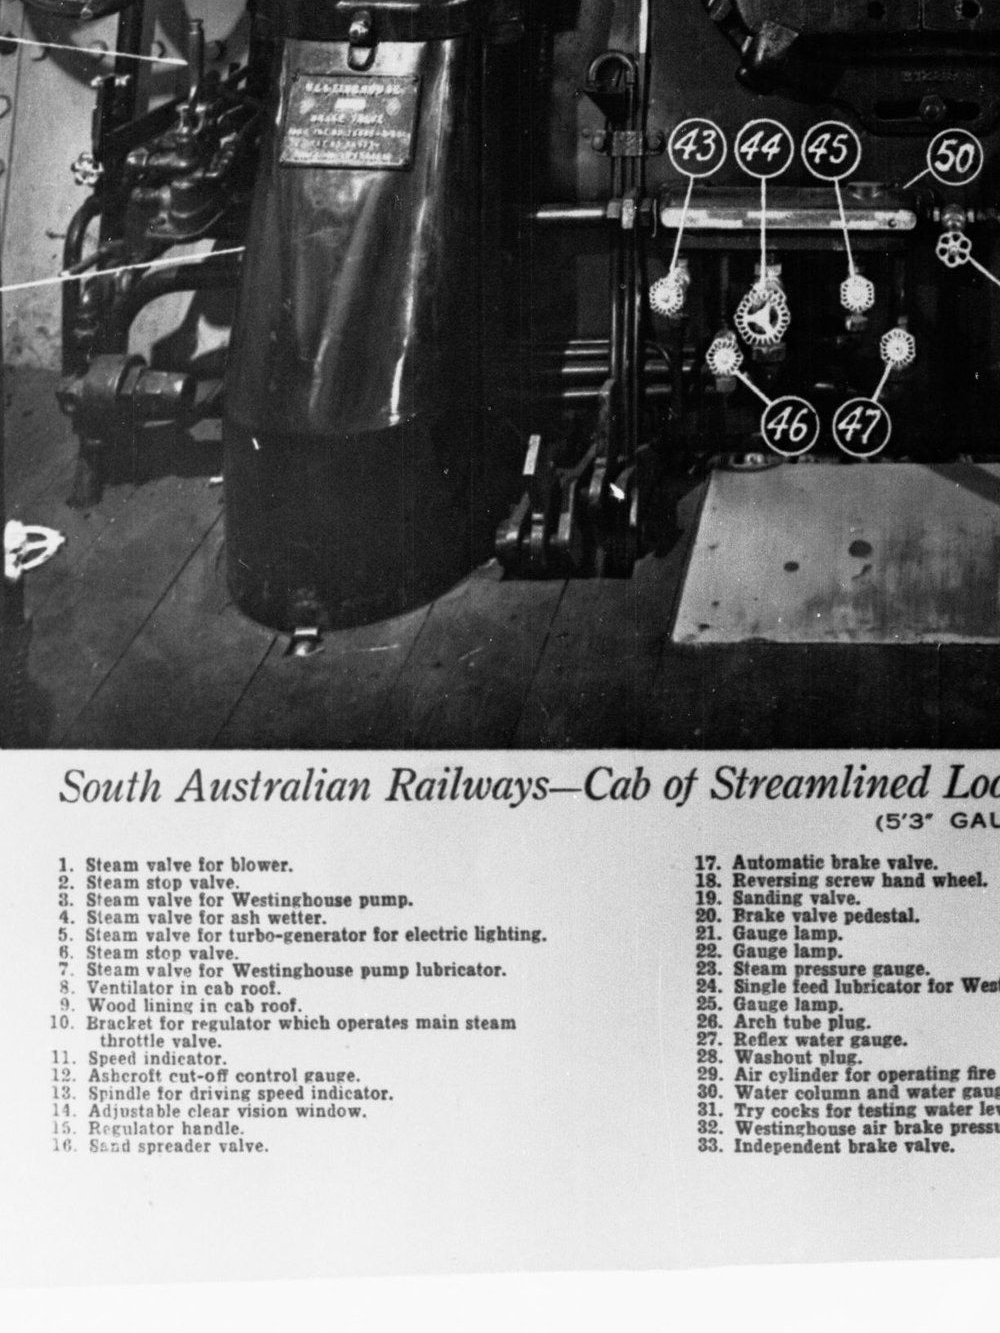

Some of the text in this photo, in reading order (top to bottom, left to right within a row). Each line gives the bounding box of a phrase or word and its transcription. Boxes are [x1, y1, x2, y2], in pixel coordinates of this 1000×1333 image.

[59, 768, 161, 803] South
[174, 767, 371, 803] Australian
[663, 767, 699, 808] of
[709, 763, 933, 801] Streamlined
[58, 857, 294, 872] 1. Steam valve for blower.
[695, 873, 989, 890] 18. Reversing screw hand wheel.
[57, 893, 414, 910] 3. Steam valve for Westinghouse pump.
[57, 927, 548, 945] 5. Steam valve for turbo-generator for electric lighting.
[695, 961, 931, 979] 23. Steam pressure gauge.
[695, 979, 723, 993] 24.
[734, 979, 787, 996] Single
[793, 980, 829, 994] feed
[835, 980, 923, 994] lubricator
[927, 979, 955, 993] for
[52, 1068, 361, 1085] 12. Ashcroft cut-off control gauge.
[696, 1067, 724, 1081] 29.
[734, 1068, 763, 1082] Air
[768, 1068, 839, 1085] cylinder
[845, 1068, 872, 1082] for
[876, 1067, 961, 1084] operating
[966, 1066, 997, 1080] fire
[696, 1120, 724, 1134] 32.
[734, 1122, 857, 1139] Westinghouse
[862, 1121, 888, 1135] air
[894, 1121, 944, 1135] brake
